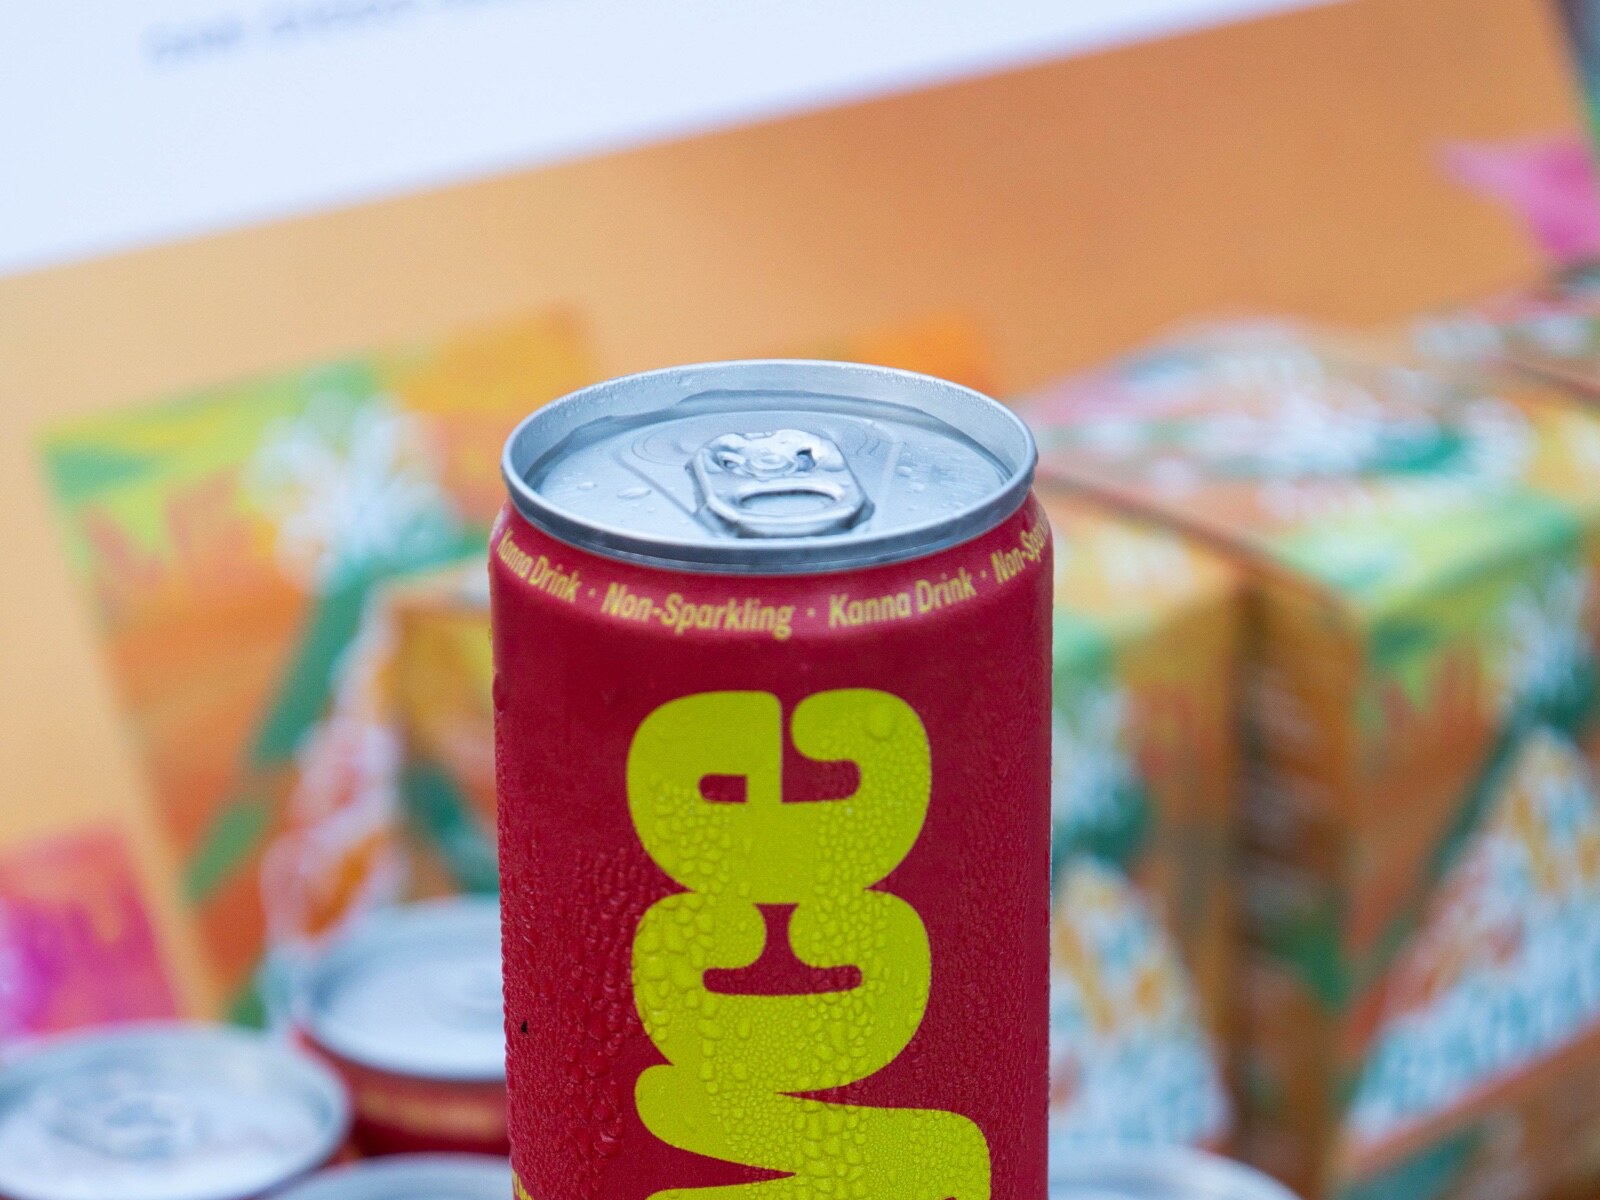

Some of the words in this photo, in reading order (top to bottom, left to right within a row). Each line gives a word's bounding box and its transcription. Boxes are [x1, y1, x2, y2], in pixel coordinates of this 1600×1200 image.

[528, 554, 582, 604] Drink
[601, 581, 795, 640] Non-Sparkling
[828, 594, 911, 629] Kanna
[916, 566, 978, 611] Drink
